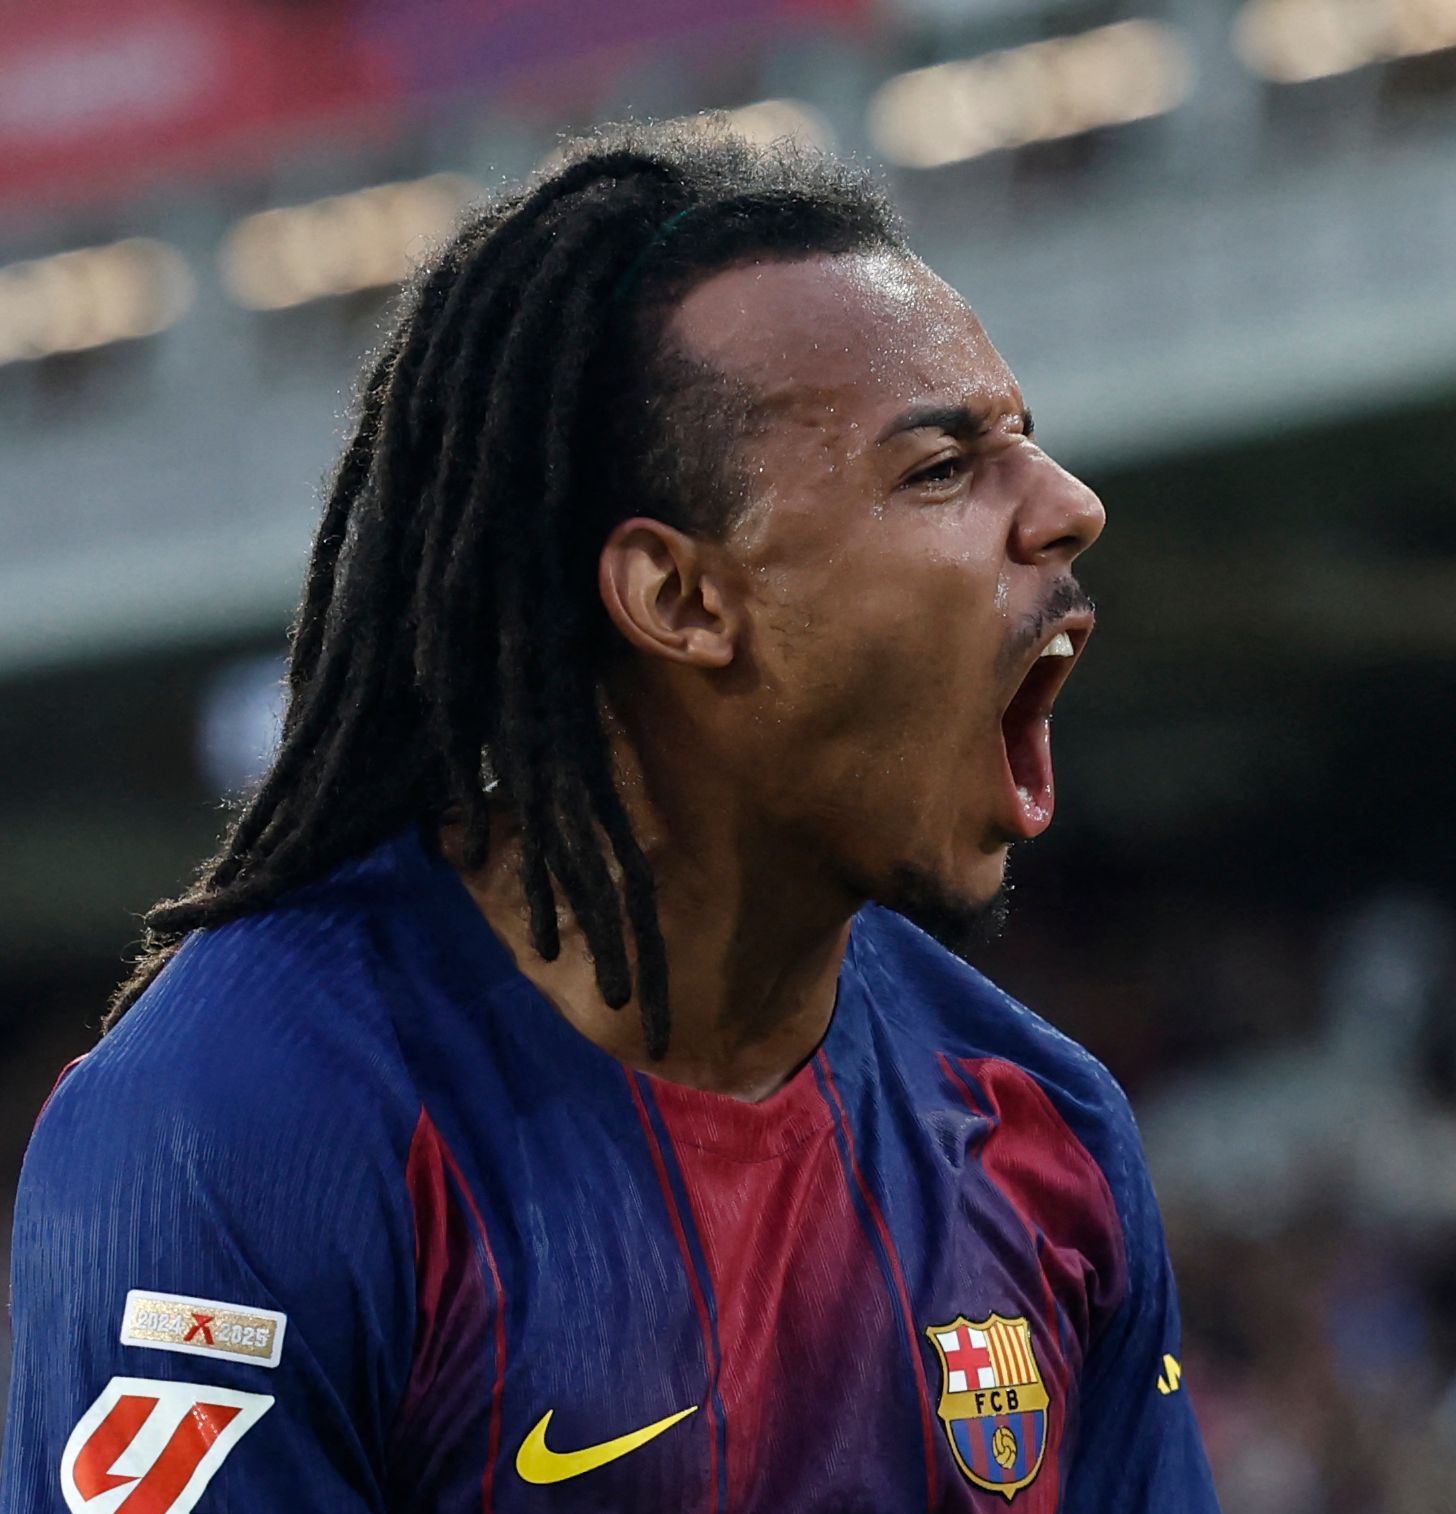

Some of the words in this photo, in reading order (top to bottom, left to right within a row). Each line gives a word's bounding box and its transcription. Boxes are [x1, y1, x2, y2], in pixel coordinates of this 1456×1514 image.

[138, 1311, 183, 1335] 2024
[218, 1322, 270, 1348] 2025
[975, 1389, 1019, 1414] FCB
